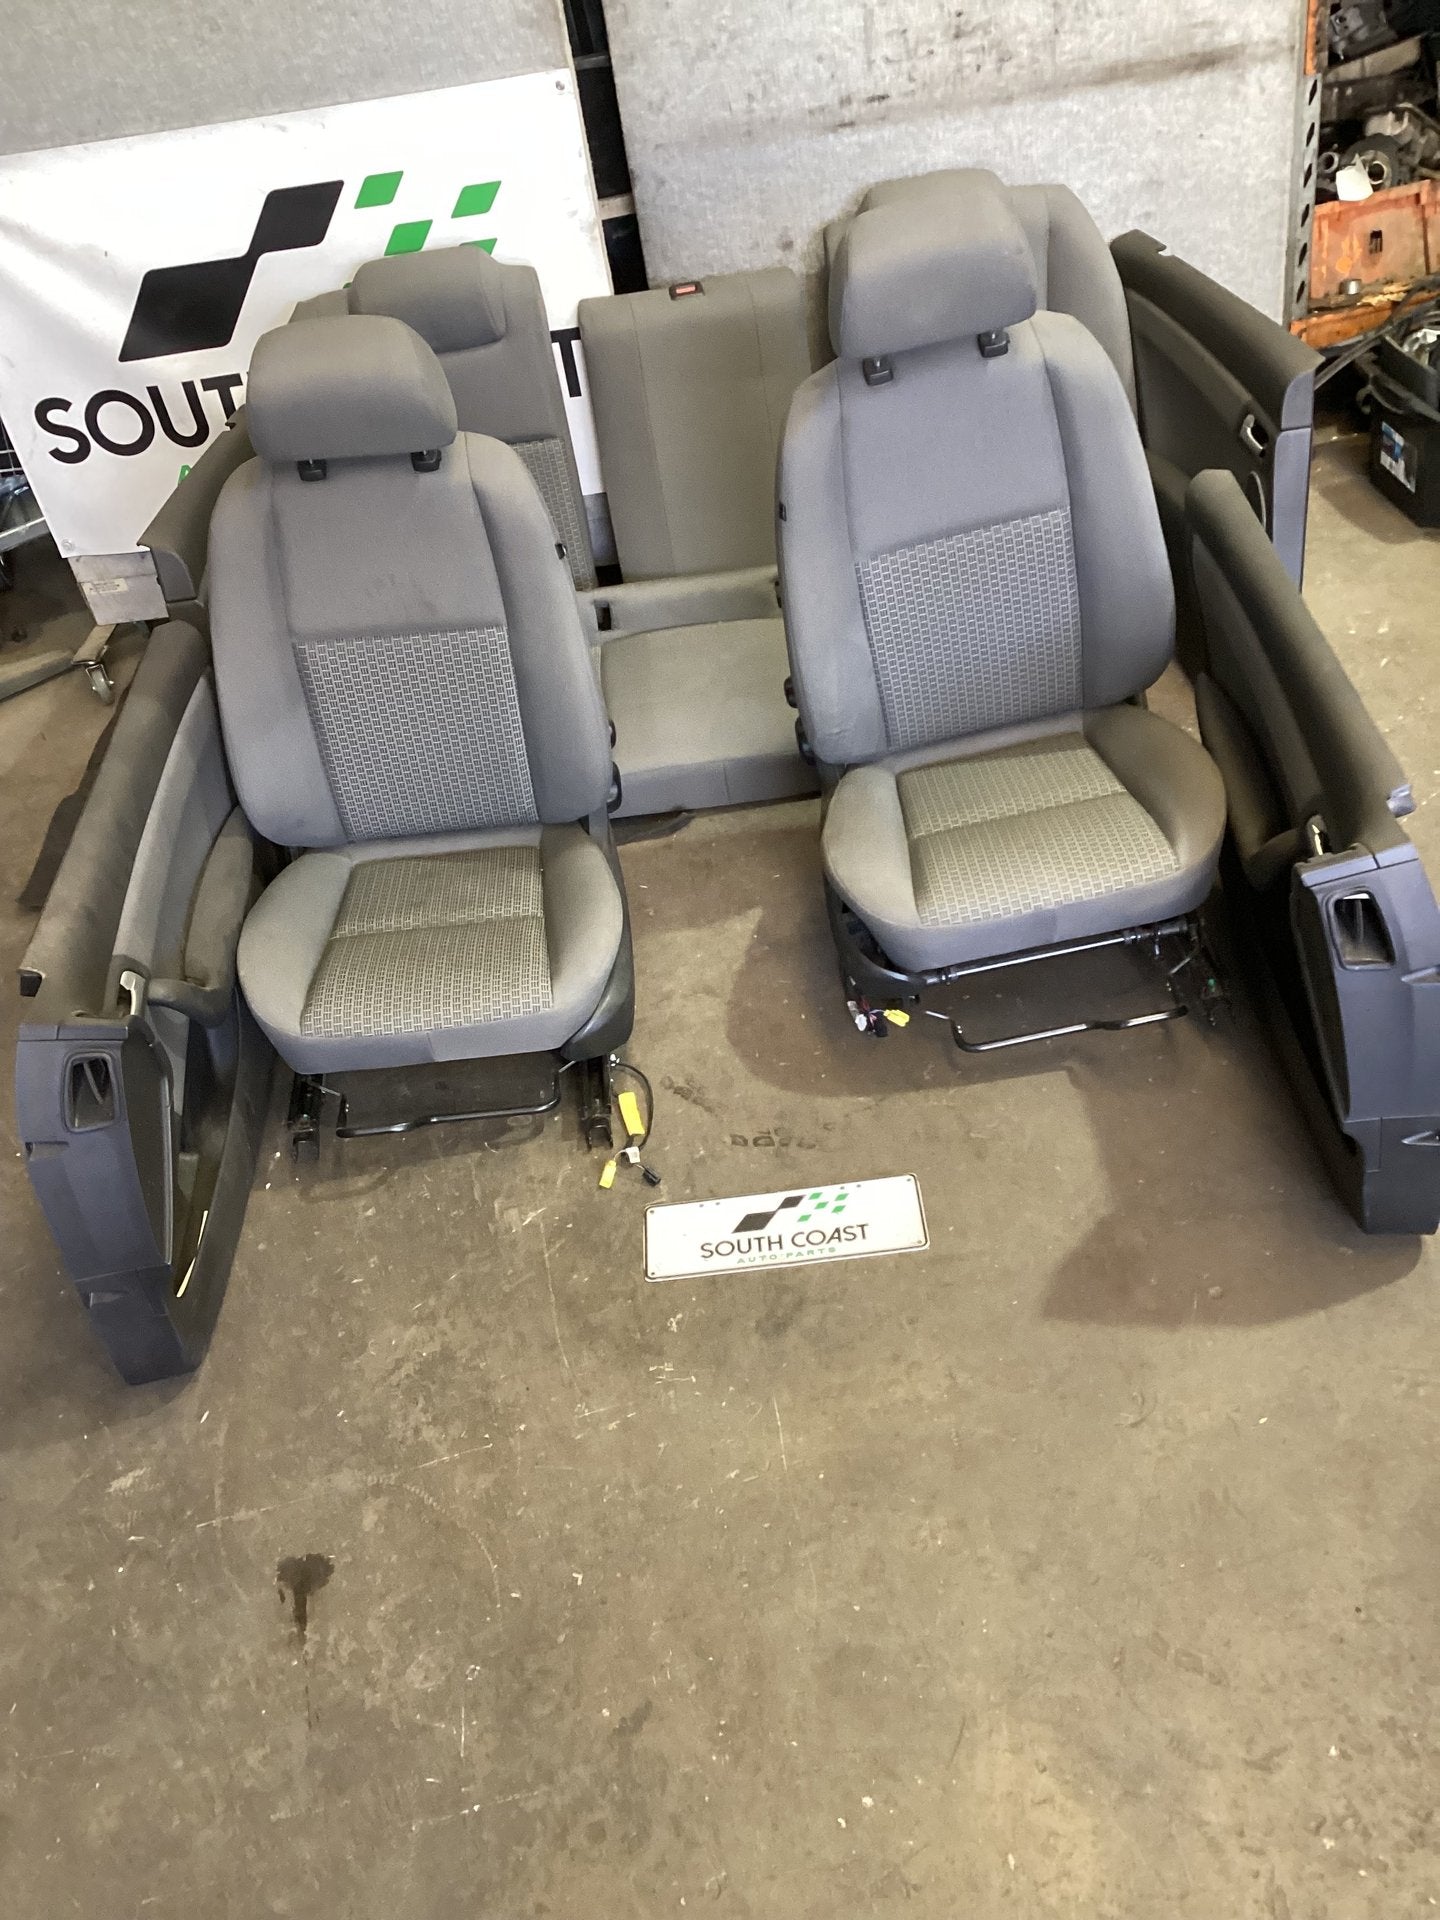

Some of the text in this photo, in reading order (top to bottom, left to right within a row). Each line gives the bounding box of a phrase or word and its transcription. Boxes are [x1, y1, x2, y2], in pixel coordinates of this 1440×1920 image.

[34, 373, 246, 464] SOUT
[700, 1223, 869, 1259] SOUTH COAST
[737, 1247, 836, 1264] AUTO PARTS
